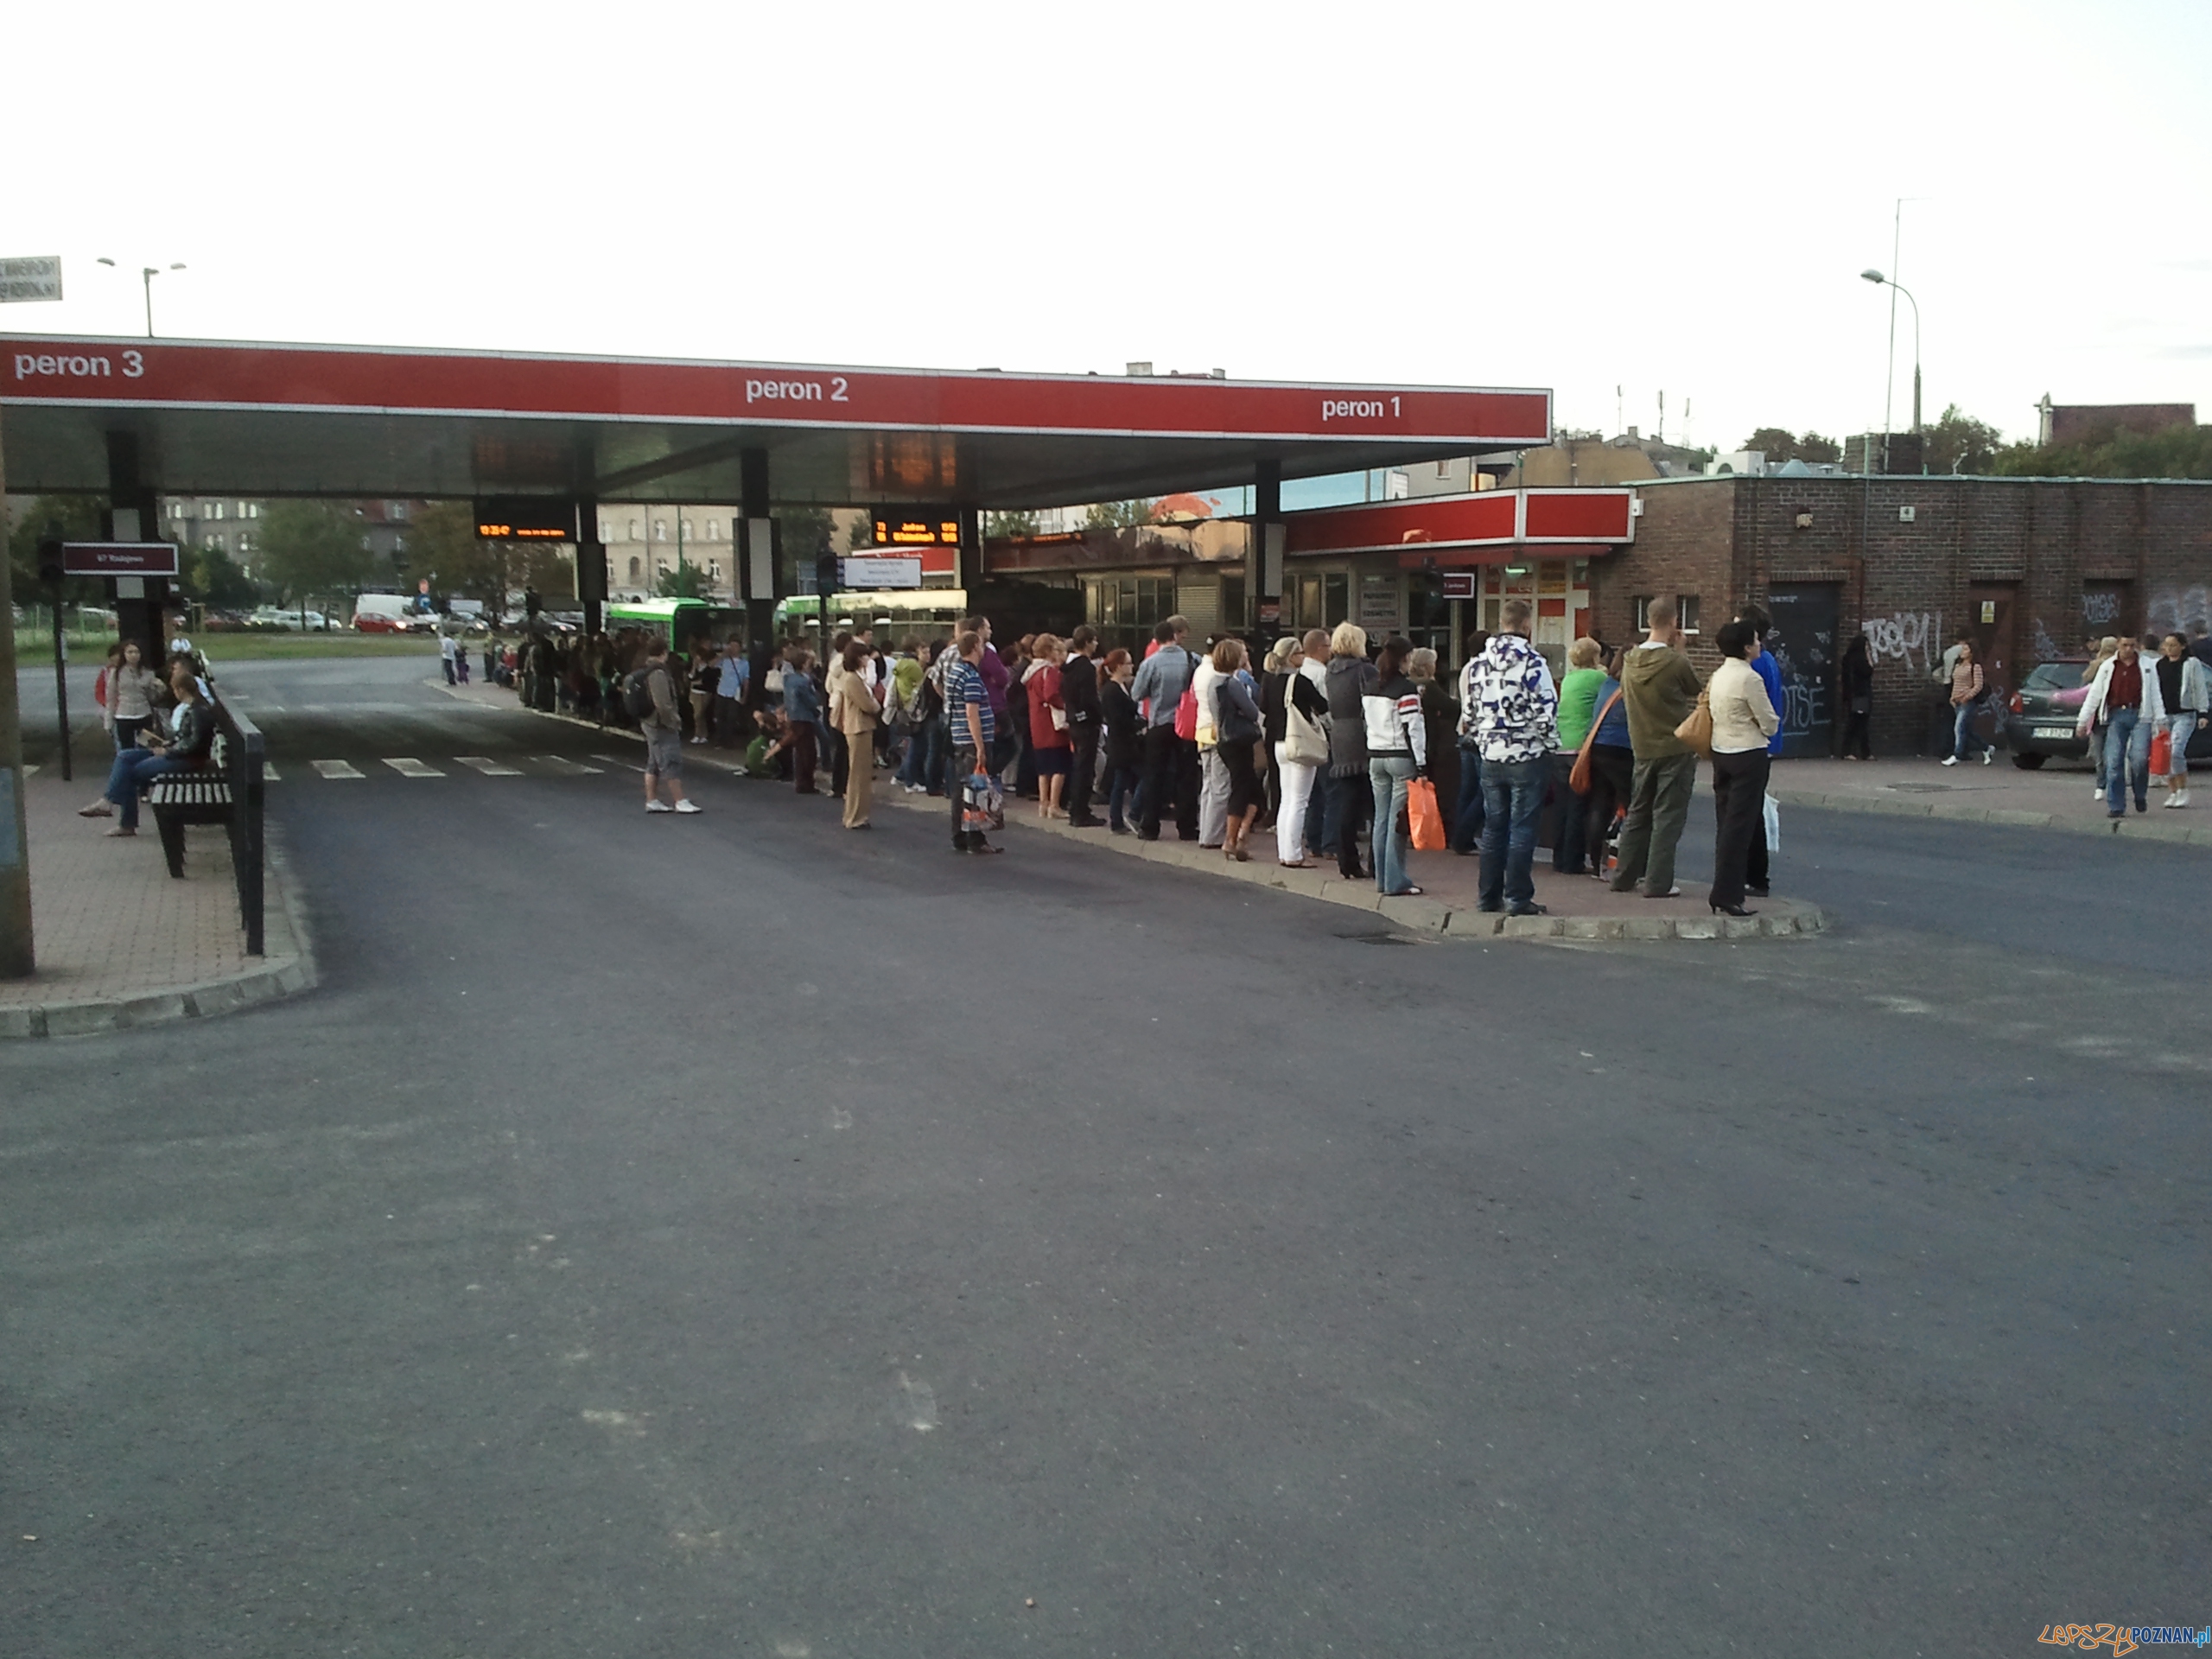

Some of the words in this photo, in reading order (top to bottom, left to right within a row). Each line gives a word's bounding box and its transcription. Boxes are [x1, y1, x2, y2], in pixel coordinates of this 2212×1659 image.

[15, 354, 111, 380] peron
[122, 350, 144, 378] 3
[746, 379, 823, 404] peron
[830, 376, 849, 403] 2
[1322, 400, 1383, 423] peron
[1390, 396, 1401, 418] 1
